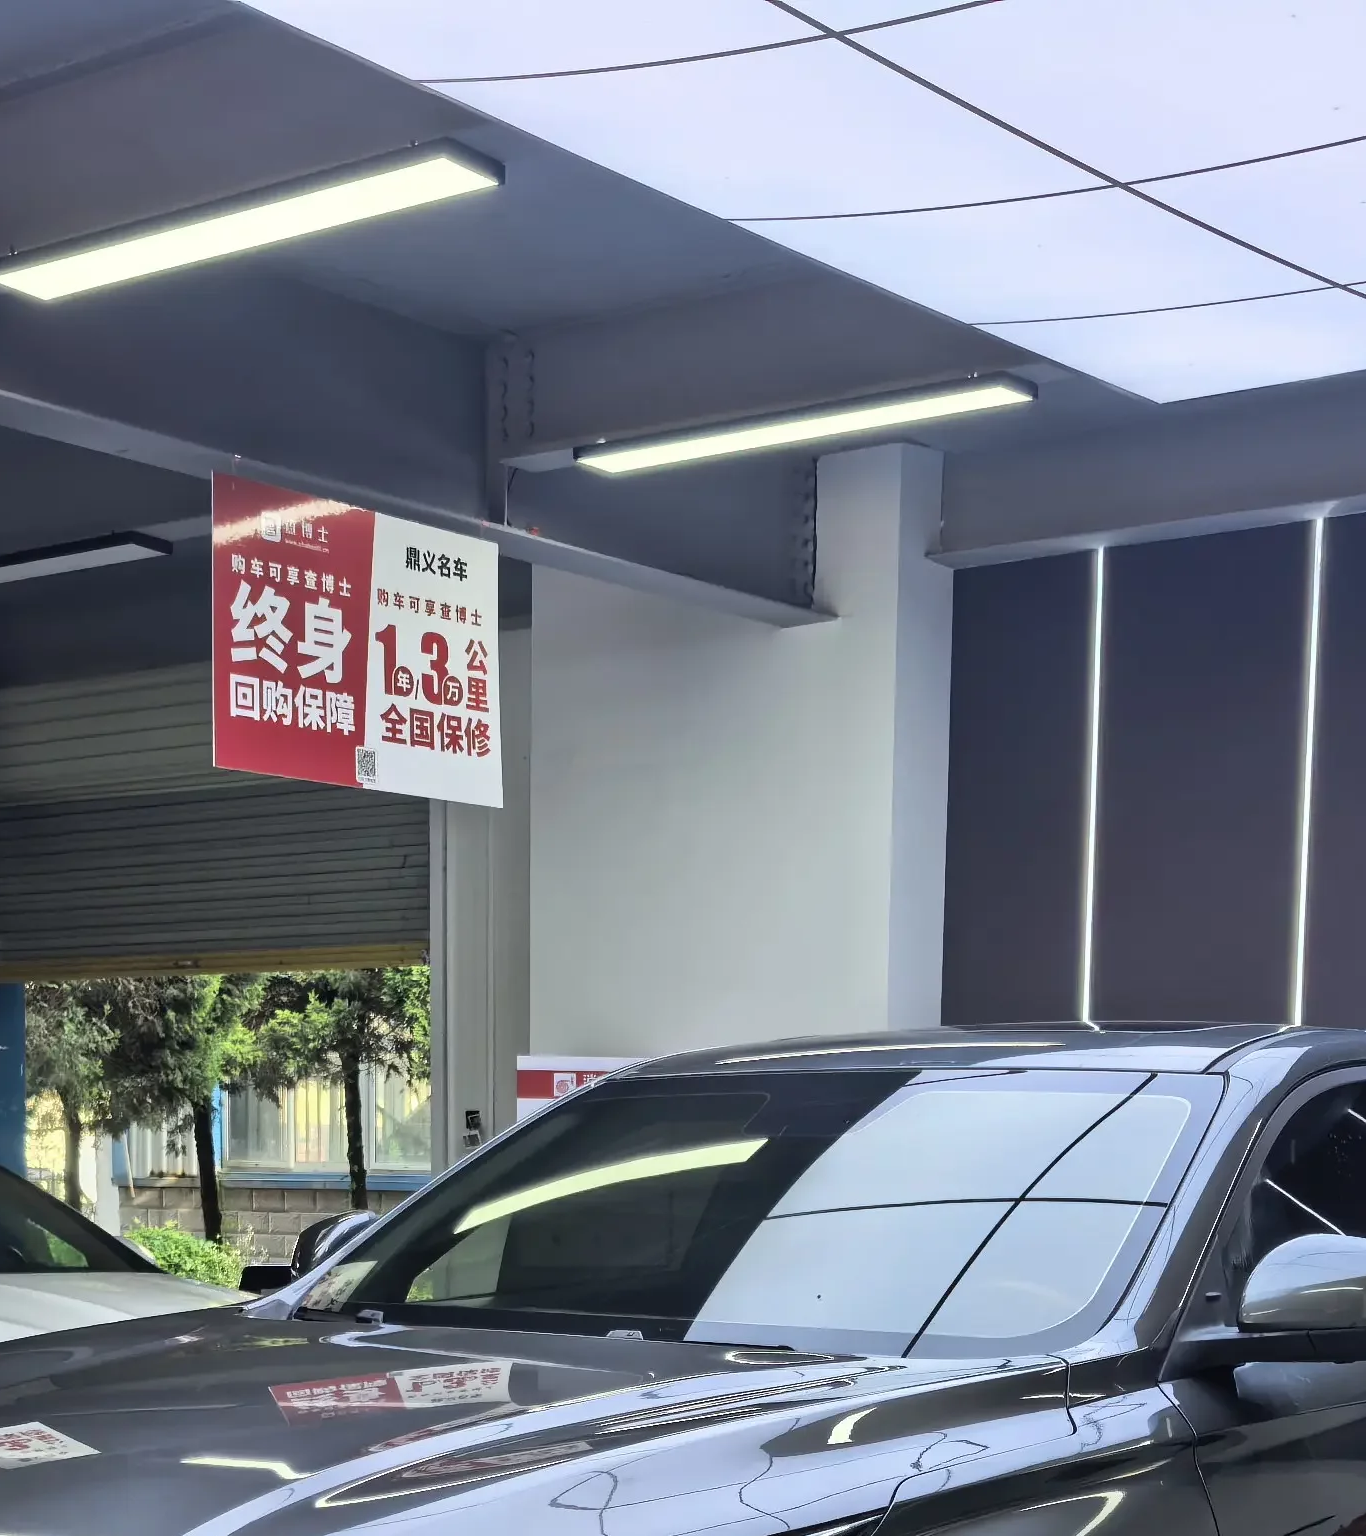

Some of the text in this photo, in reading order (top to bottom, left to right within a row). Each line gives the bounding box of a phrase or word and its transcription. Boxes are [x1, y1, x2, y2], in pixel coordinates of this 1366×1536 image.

[231, 553, 352, 597] 购车可享查博士
[405, 545, 469, 583] 鼎义名车
[229, 579, 353, 684] 终身
[377, 588, 483, 628] 购车可享查博士
[229, 672, 356, 736] 回购保障
[380, 703, 491, 758] 全国保修
